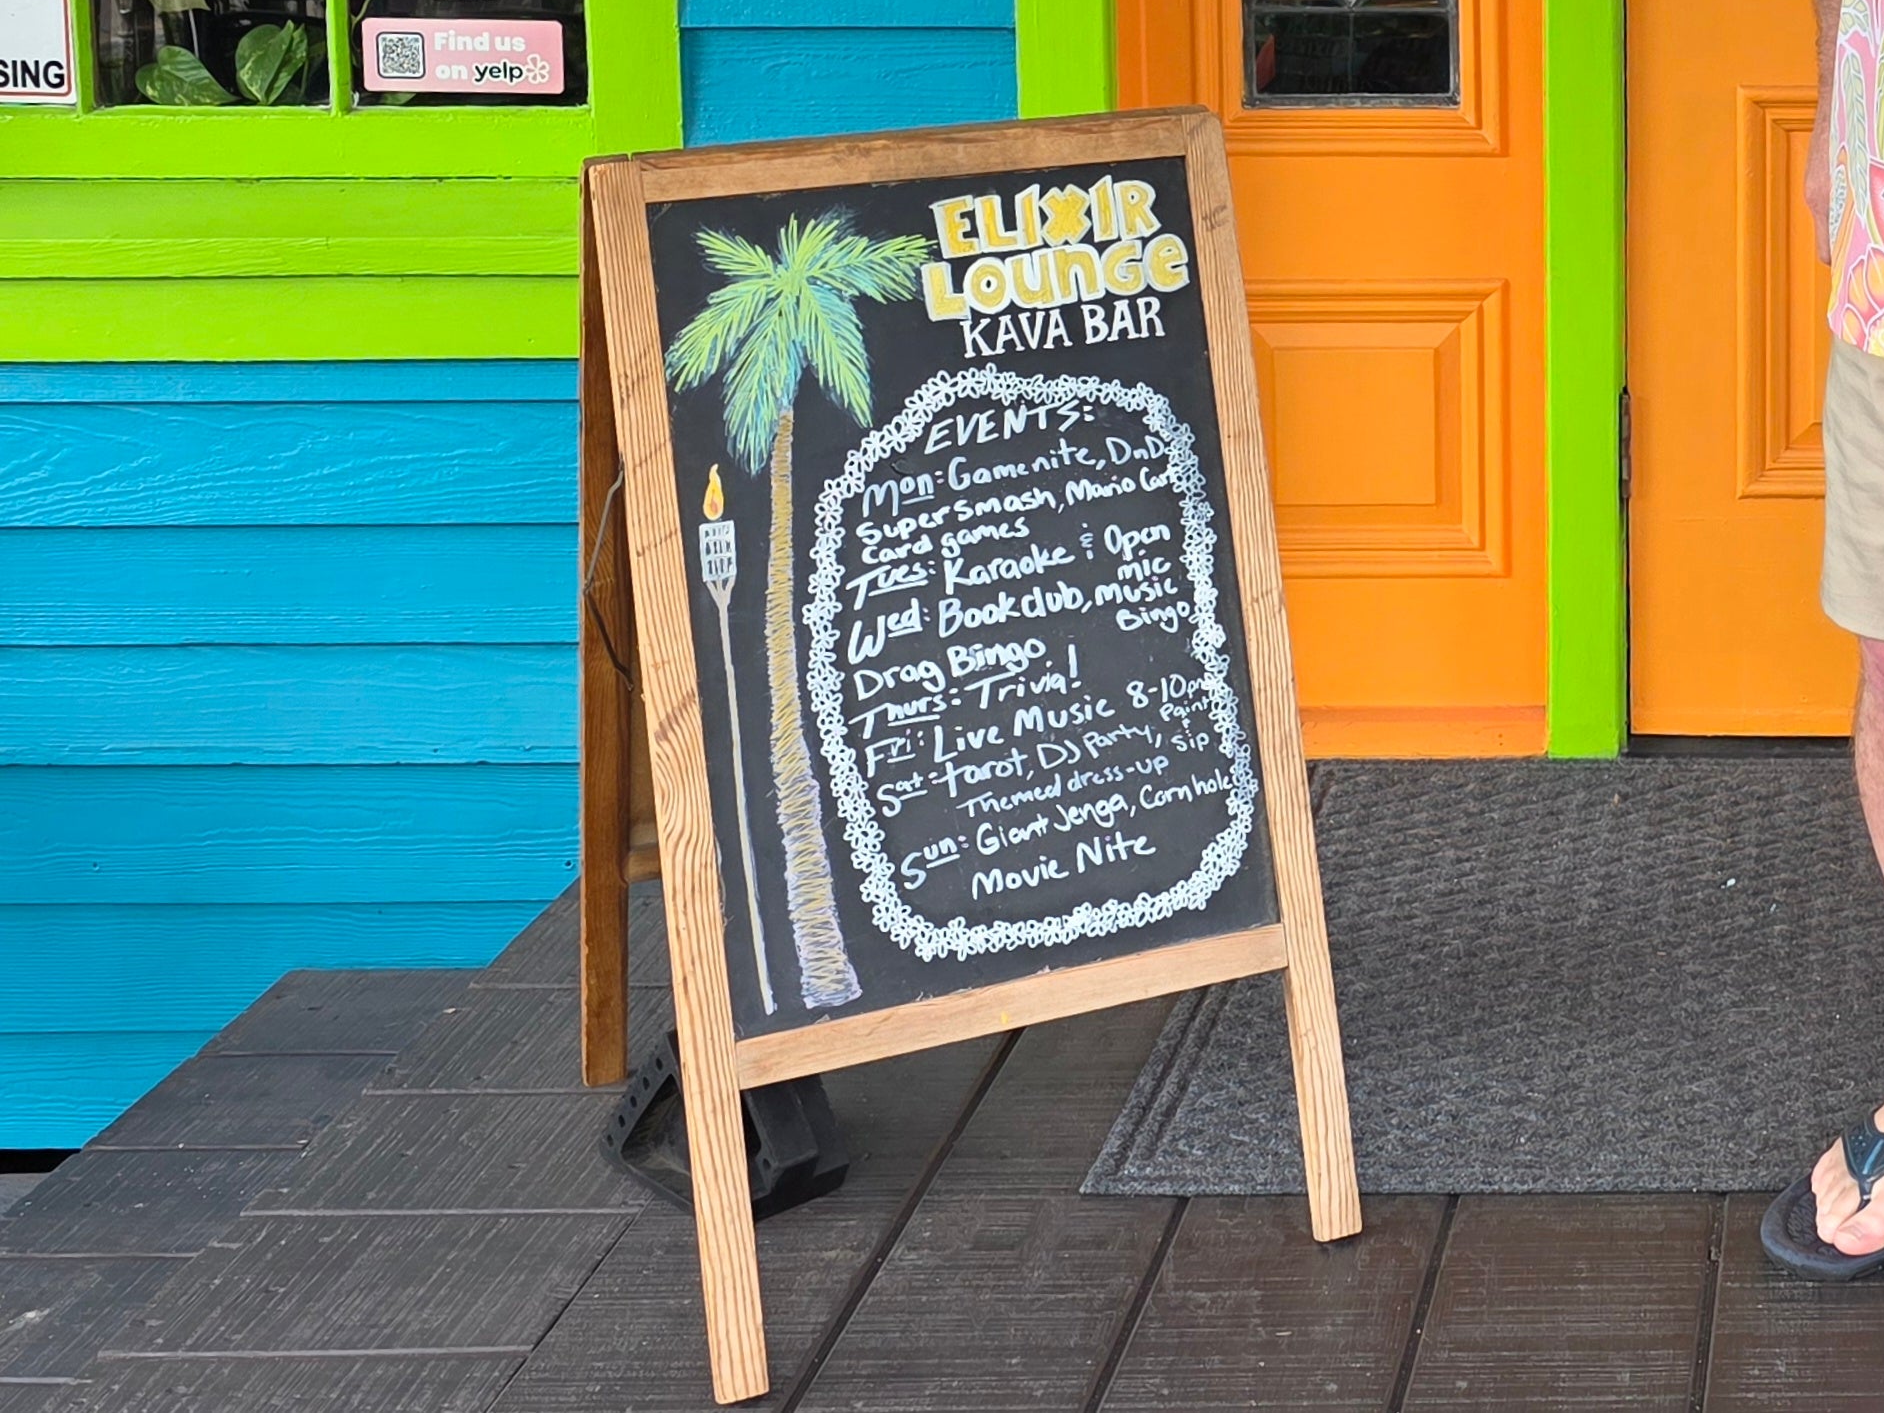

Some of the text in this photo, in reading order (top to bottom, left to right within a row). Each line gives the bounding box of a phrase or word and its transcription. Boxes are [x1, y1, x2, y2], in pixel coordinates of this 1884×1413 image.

[434, 29, 526, 52] Find us
[435, 61, 523, 83] on yelp
[929, 174, 1162, 260] ELIXIR
[960, 296, 1166, 359] KAVA BAR
[924, 399, 1094, 455] EVENTS:
[856, 504, 954, 546] Super
[862, 469, 945, 517] Mon:
[846, 559, 936, 611] Tues:
[944, 544, 1076, 596] Karaoke
[1104, 524, 1171, 561] Open
[941, 517, 1030, 559] games
[847, 599, 931, 665] Wed:
[1115, 600, 1191, 634] Bingo
[848, 645, 1082, 740] Thurs: Trivia!
[853, 637, 1047, 702] Drag Bingo
[864, 730, 926, 778] Fri:
[934, 724, 1004, 763] Live
[1013, 695, 1116, 737] Music
[1158, 696, 1211, 722] Paint
[876, 772, 937, 817] Sat:
[1037, 740, 1080, 770] DJ
[1083, 723, 1163, 760] Party,
[956, 754, 1170, 819] Themed dress-up
[900, 833, 968, 890] Sun:
[974, 815, 1050, 856] Giant
[1052, 789, 1136, 833] Jenga,
[972, 830, 1156, 900] Movie Nite
